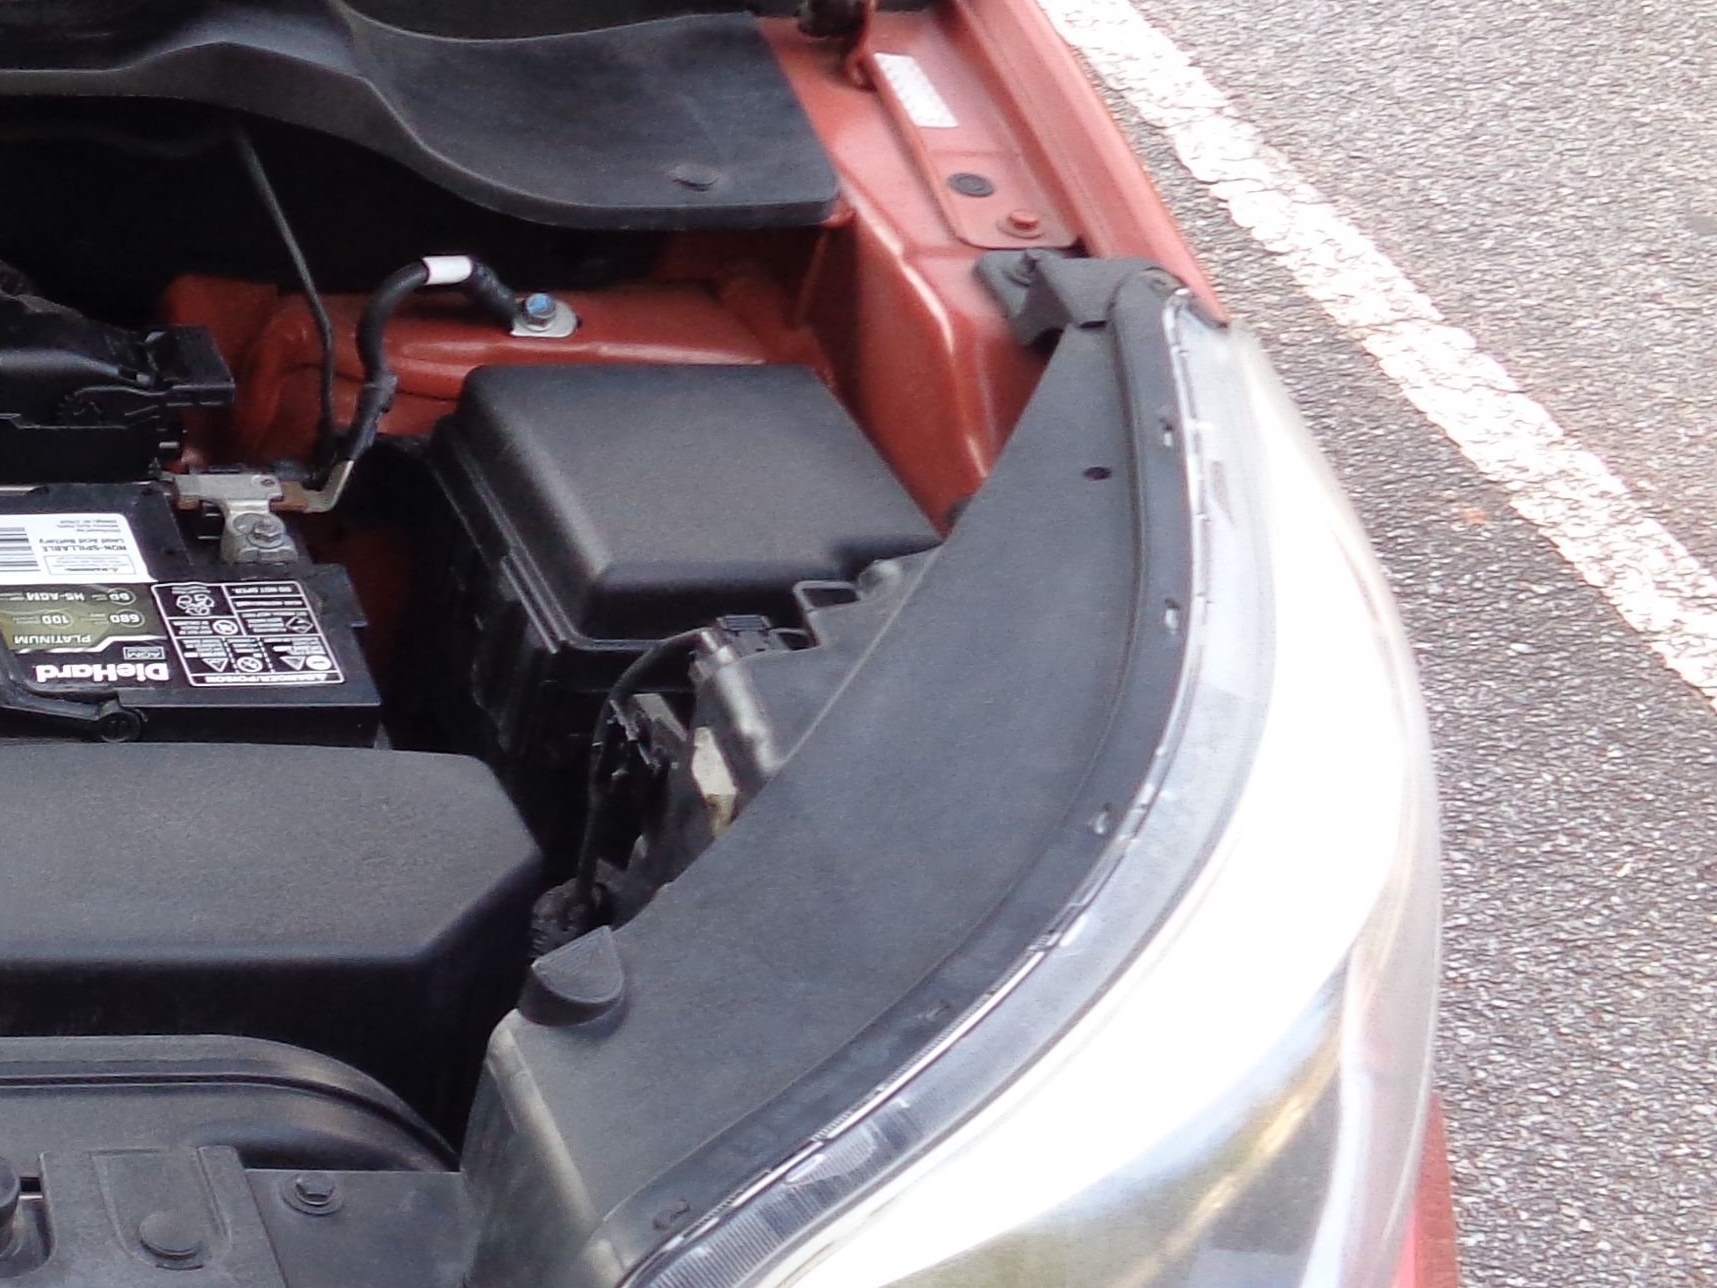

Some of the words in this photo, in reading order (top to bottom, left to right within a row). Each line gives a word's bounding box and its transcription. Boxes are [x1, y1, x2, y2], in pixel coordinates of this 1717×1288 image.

[41, 614, 70, 625] 100
[109, 613, 141, 624] 680
[14, 634, 92, 645] PLATINUM
[36, 663, 169, 682] DieHard
